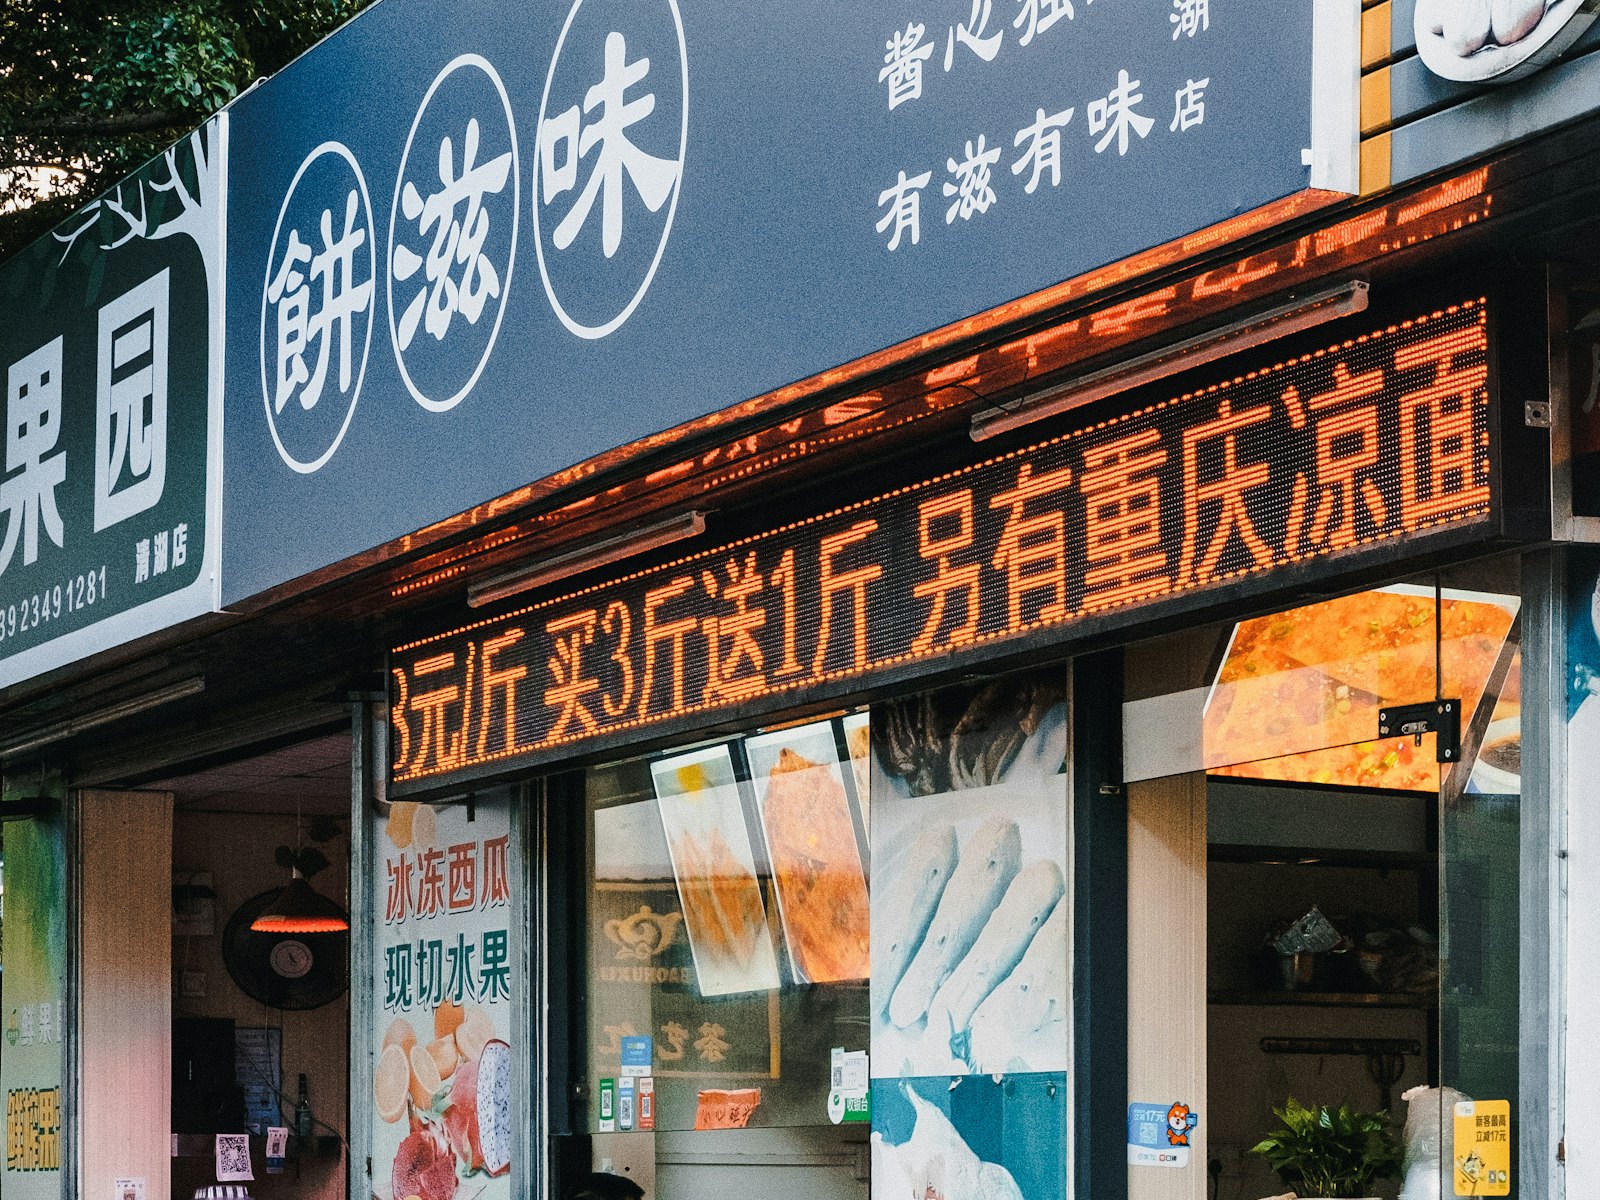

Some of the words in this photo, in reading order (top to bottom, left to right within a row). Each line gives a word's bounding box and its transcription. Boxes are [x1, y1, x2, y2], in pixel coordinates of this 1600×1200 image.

[876, 69, 1155, 251] 有滋有味
[545, 519, 882, 743] 买3斤送1斤
[914, 324, 1489, 652] 另有重庆凉面
[21, 585, 61, 631] 2349
[67, 565, 106, 613] 1281
[385, 833, 510, 923] 冰冻西瓜
[384, 928, 511, 1011] 现切水果
[21, 1000, 62, 1046] 鲜果
[1475, 1114, 1507, 1128] 新客最高
[1475, 1130, 1507, 1142] 立减17元
